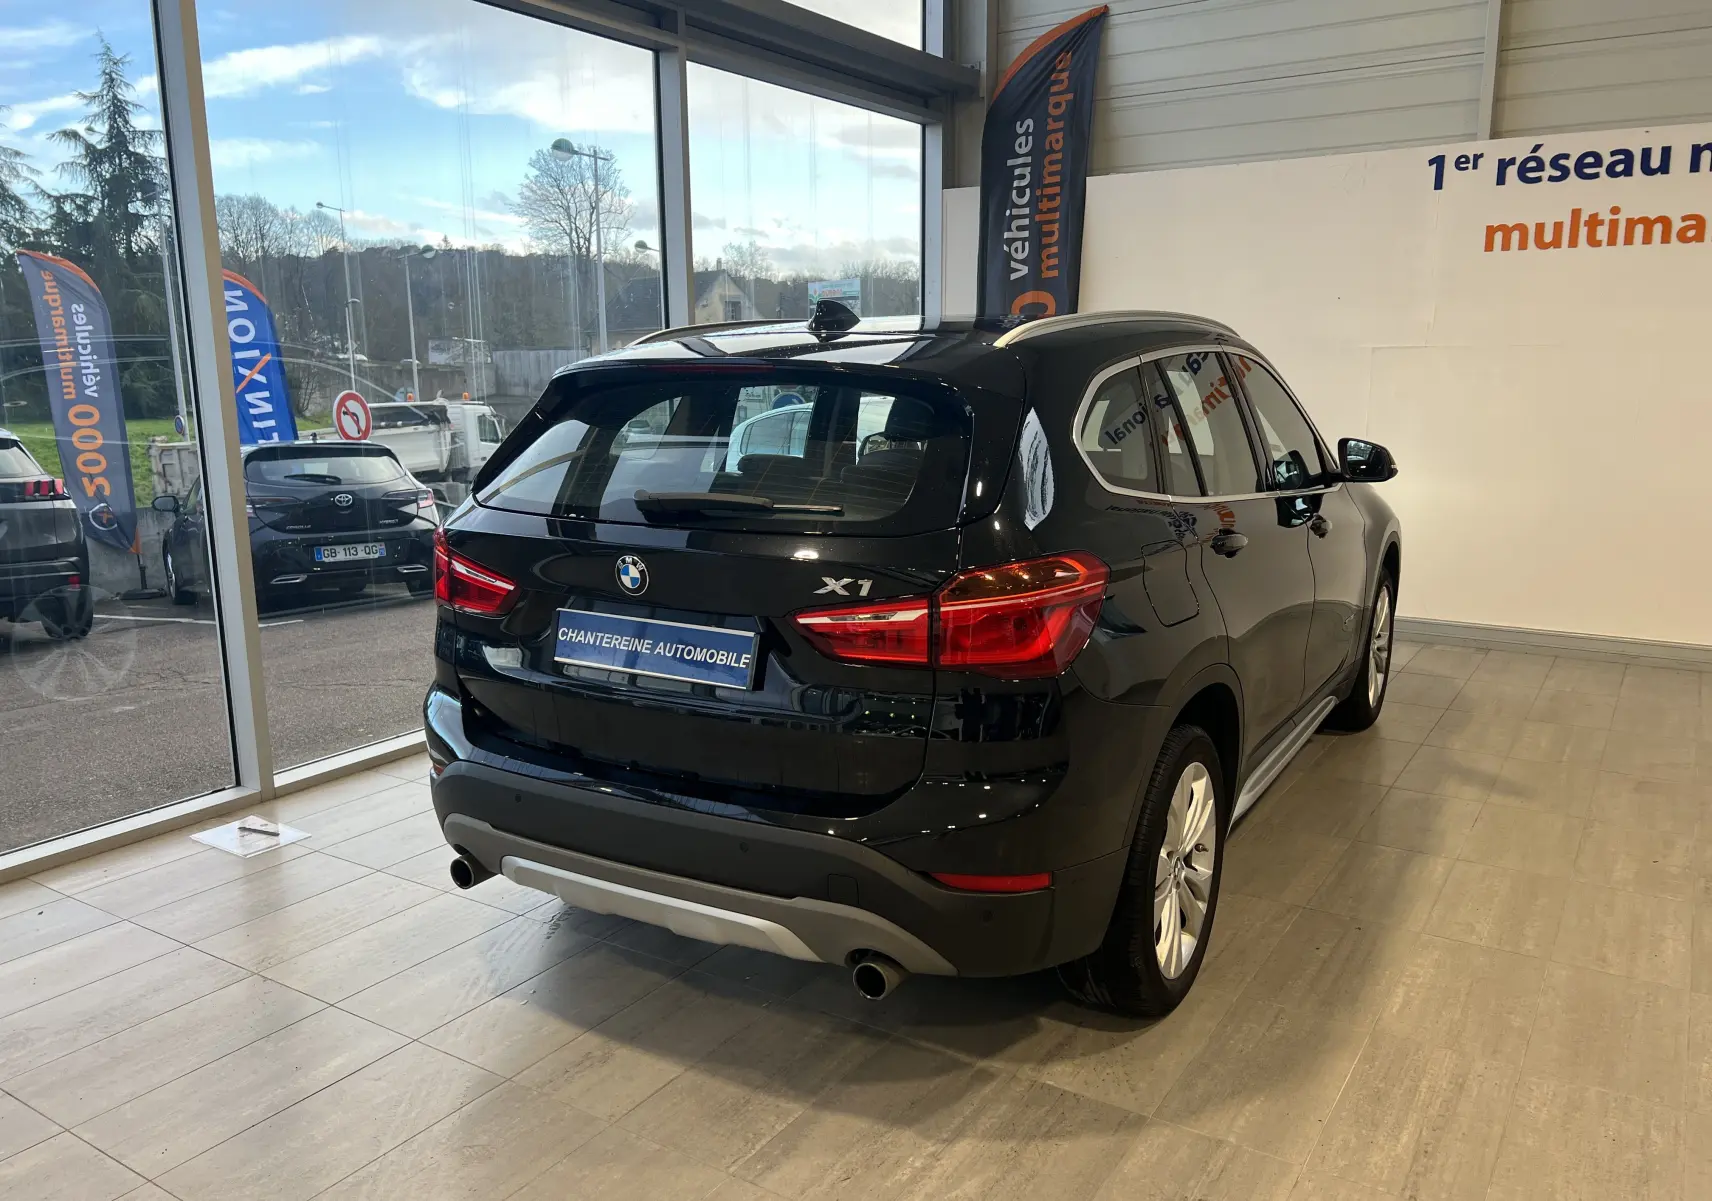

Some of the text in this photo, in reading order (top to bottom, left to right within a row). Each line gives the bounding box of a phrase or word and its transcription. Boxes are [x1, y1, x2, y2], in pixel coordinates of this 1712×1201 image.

[1035, 50, 1074, 279] multimarque
[1495, 143, 1672, 187] réseau
[1003, 118, 1034, 281] véhicules
[1484, 205, 1707, 253] multima
[813, 576, 873, 597] X1
[558, 627, 751, 669] CHANTEREINE AUTOMOBILE
